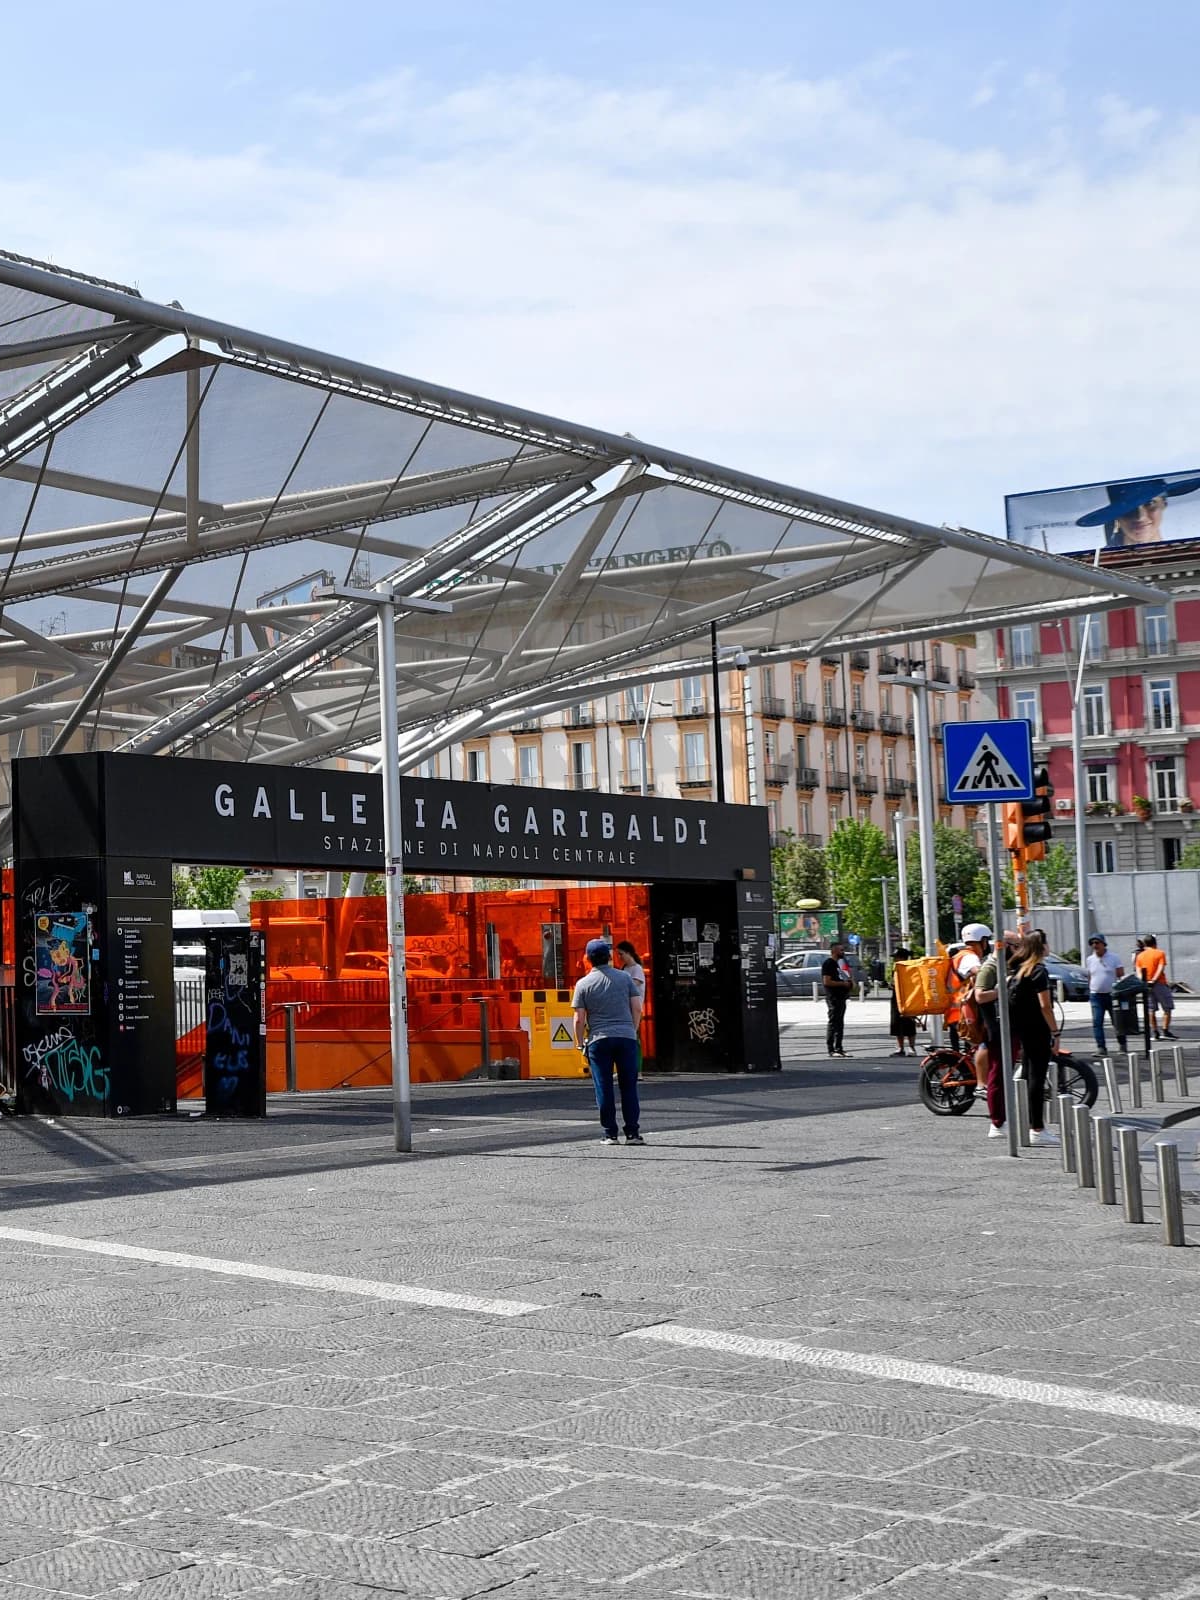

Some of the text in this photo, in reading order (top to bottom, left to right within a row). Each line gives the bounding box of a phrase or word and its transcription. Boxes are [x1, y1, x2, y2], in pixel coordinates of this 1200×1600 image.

[214, 783, 708, 845] GALLEIA GARIBALDI
[323, 835, 636, 865] STAZINE DI NAPOLI CENTRALE
